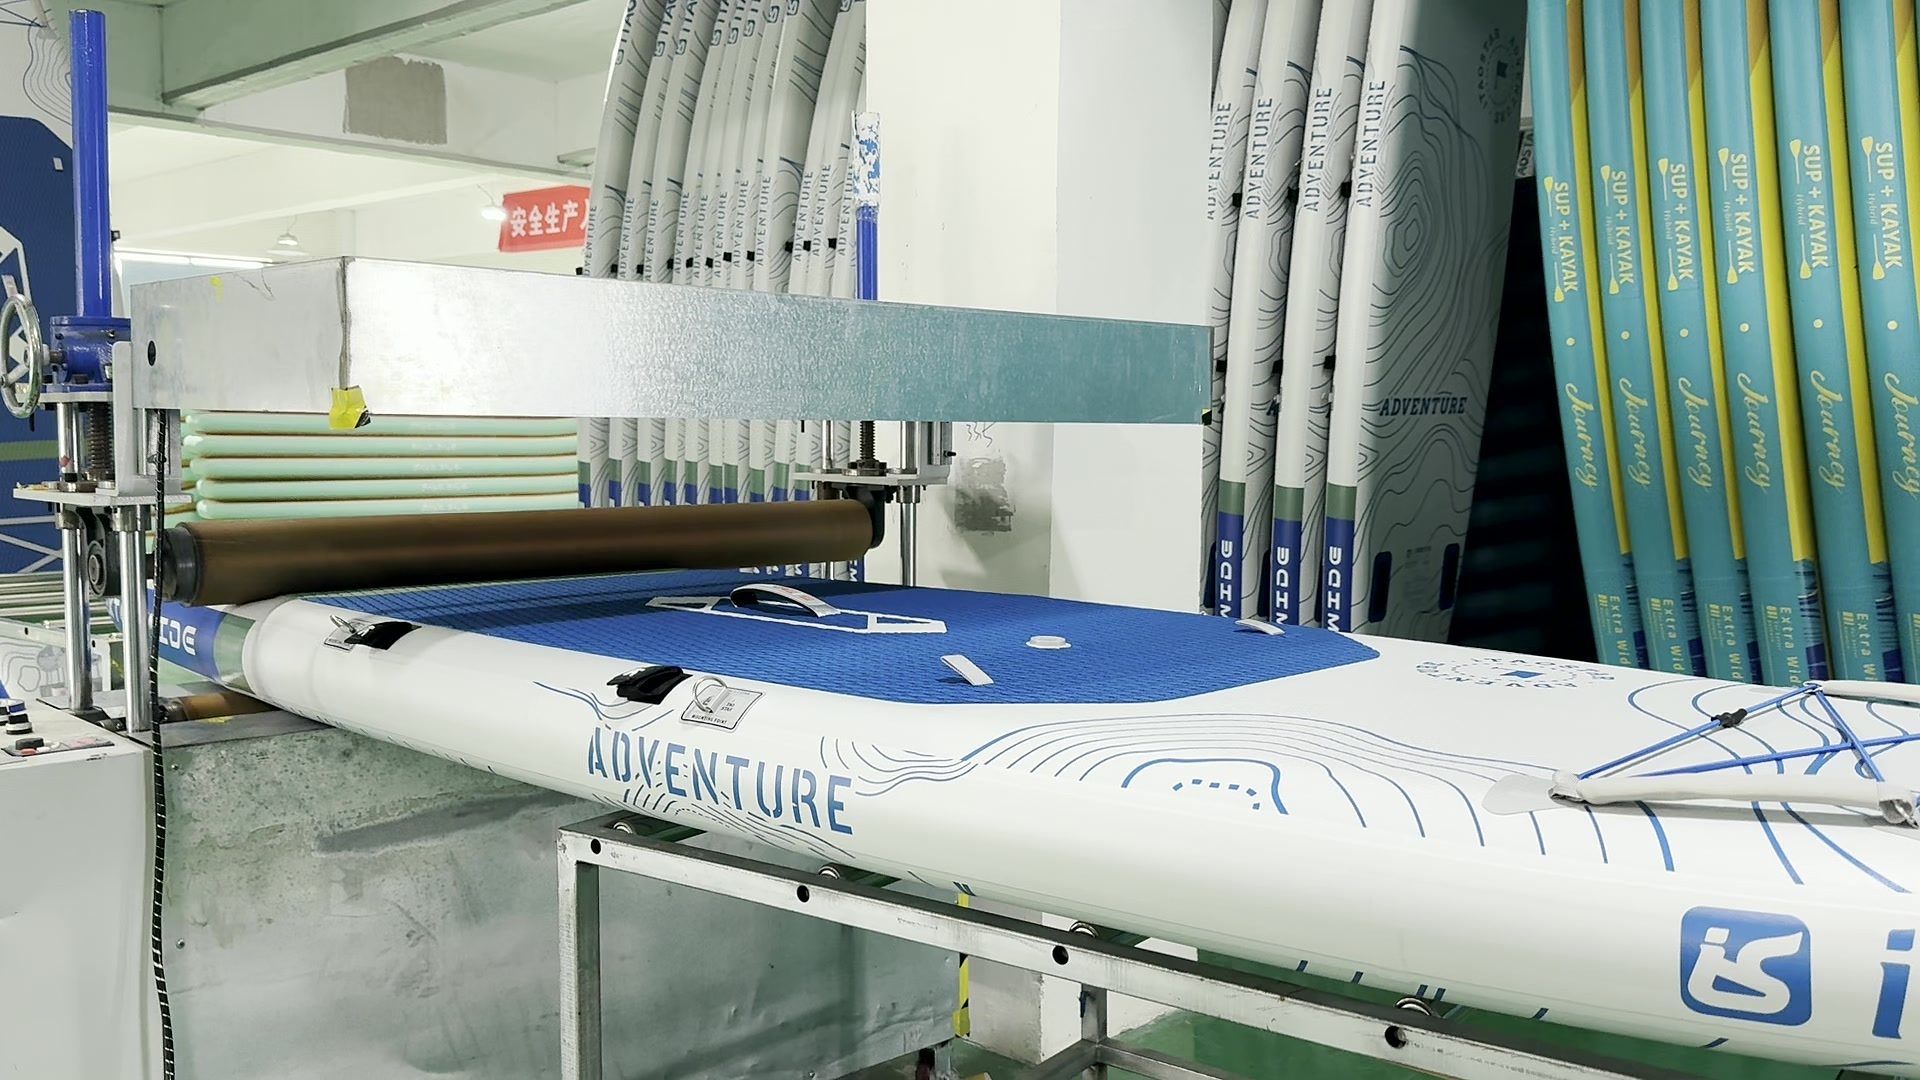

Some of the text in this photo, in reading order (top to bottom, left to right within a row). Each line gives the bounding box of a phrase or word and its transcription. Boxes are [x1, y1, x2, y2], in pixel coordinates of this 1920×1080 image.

[1207, 102, 1232, 220] ADVENTURE
[1245, 97, 1273, 219] ADVENTURE
[1303, 87, 1332, 212] ADVENTURE
[1356, 80, 1385, 207] ADVENTURE
[1670, 164, 1688, 198] SUP
[1731, 153, 1748, 190] SUP
[1804, 144, 1822, 182] SUP
[1876, 142, 1894, 179] SUP
[733, 180, 749, 267] ADVENTURE
[756, 176, 771, 266] ADVENTURE
[793, 171, 813, 261] ADVENTURE
[812, 164, 831, 256] ADVENTURE
[1554, 182, 1571, 216] SUP
[1611, 171, 1628, 205] SUP
[583, 206, 597, 277] DVENTURE
[619, 198, 635, 278] ADVENTURE
[674, 192, 690, 274] ADVENTURE
[693, 195, 708, 279] ADVENTURE
[714, 192, 727, 278] ADVENTURE
[1559, 236, 1578, 292] KAYAK
[1615, 226, 1634, 284] KAYAK
[1675, 221, 1694, 280] KAYAK
[1735, 212, 1755, 273] KAYAK
[1807, 204, 1829, 269] KAYAK
[1880, 203, 1903, 269] KAYAK
[1379, 396, 1468, 417] ADVENTURE
[1565, 383, 1598, 488] Journey
[1619, 378, 1651, 489] Journey
[1678, 377, 1712, 488] Journey
[1737, 373, 1771, 492] Journey
[1810, 370, 1846, 493] Journey
[1884, 373, 1920, 498] Journey
[1327, 546, 1342, 632] WIDE
[1609, 595, 1623, 634] Extra
[1722, 605, 1736, 646] Extra
[149, 612, 197, 656] IDE
[1663, 599, 1685, 673] Extra Wid
[1780, 607, 1802, 686] Extra Wid
[1857, 613, 1871, 656] Extra
[587, 726, 854, 835] ADVENTURE
